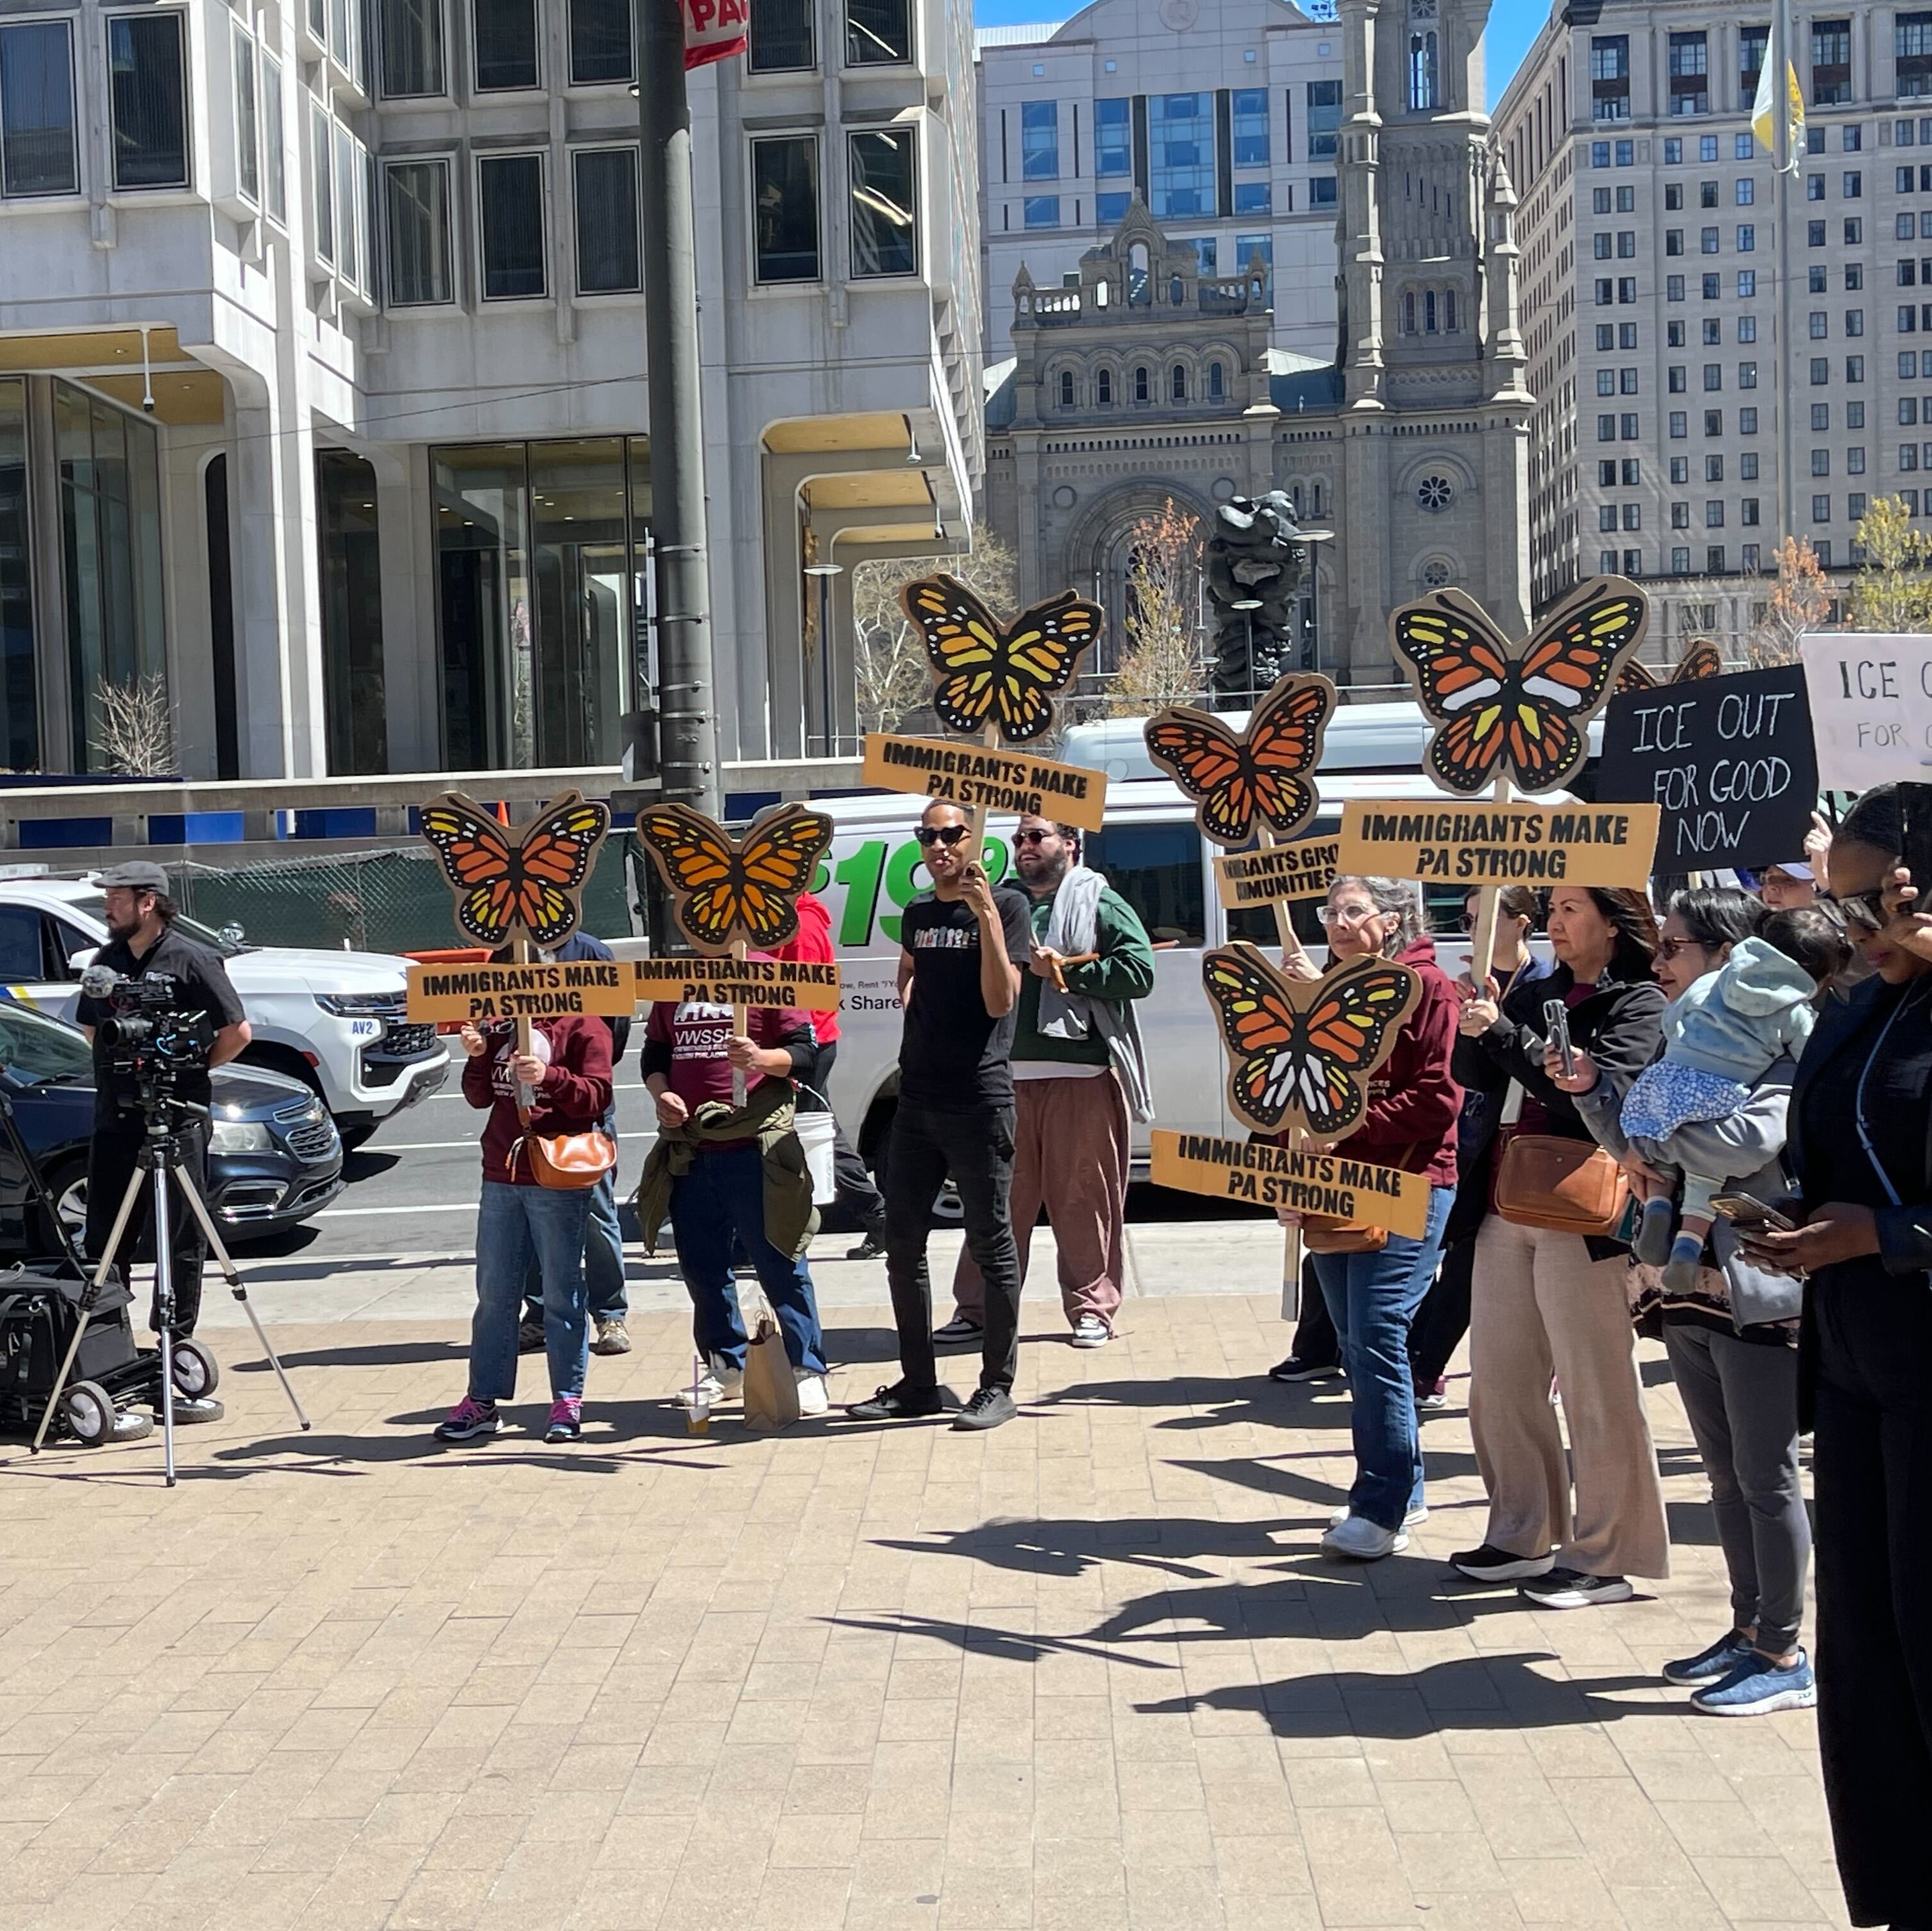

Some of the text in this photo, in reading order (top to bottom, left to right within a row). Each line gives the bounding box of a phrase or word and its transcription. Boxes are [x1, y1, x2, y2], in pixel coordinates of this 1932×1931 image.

[1839, 660, 1899, 699] ICE
[1632, 693, 1796, 752] ICE OUT
[1857, 722, 1910, 748] FOR
[883, 741, 1088, 799] IMMIGRANTS MAKE
[1654, 756, 1792, 810] FOR GOOD
[927, 774, 1043, 815] PA STRONG
[1361, 814, 1629, 845] IMMIGRANTS MAKE
[1676, 810, 1751, 856] NOW
[1301, 843, 1339, 868] GRO
[1415, 847, 1567, 879] PA STRONG
[423, 966, 619, 996] IMMIGRANTS MAKE
[635, 960, 836, 985] IMMIGRANTS MAKE
[470, 991, 583, 1017] PA STRONG
[683, 983, 796, 1006] PA STRONG
[352, 1020, 373, 1034] AV2
[1178, 1135, 1401, 1197] IMMIGRANTS MAKE
[1227, 1170, 1355, 1218] PA STRONG
